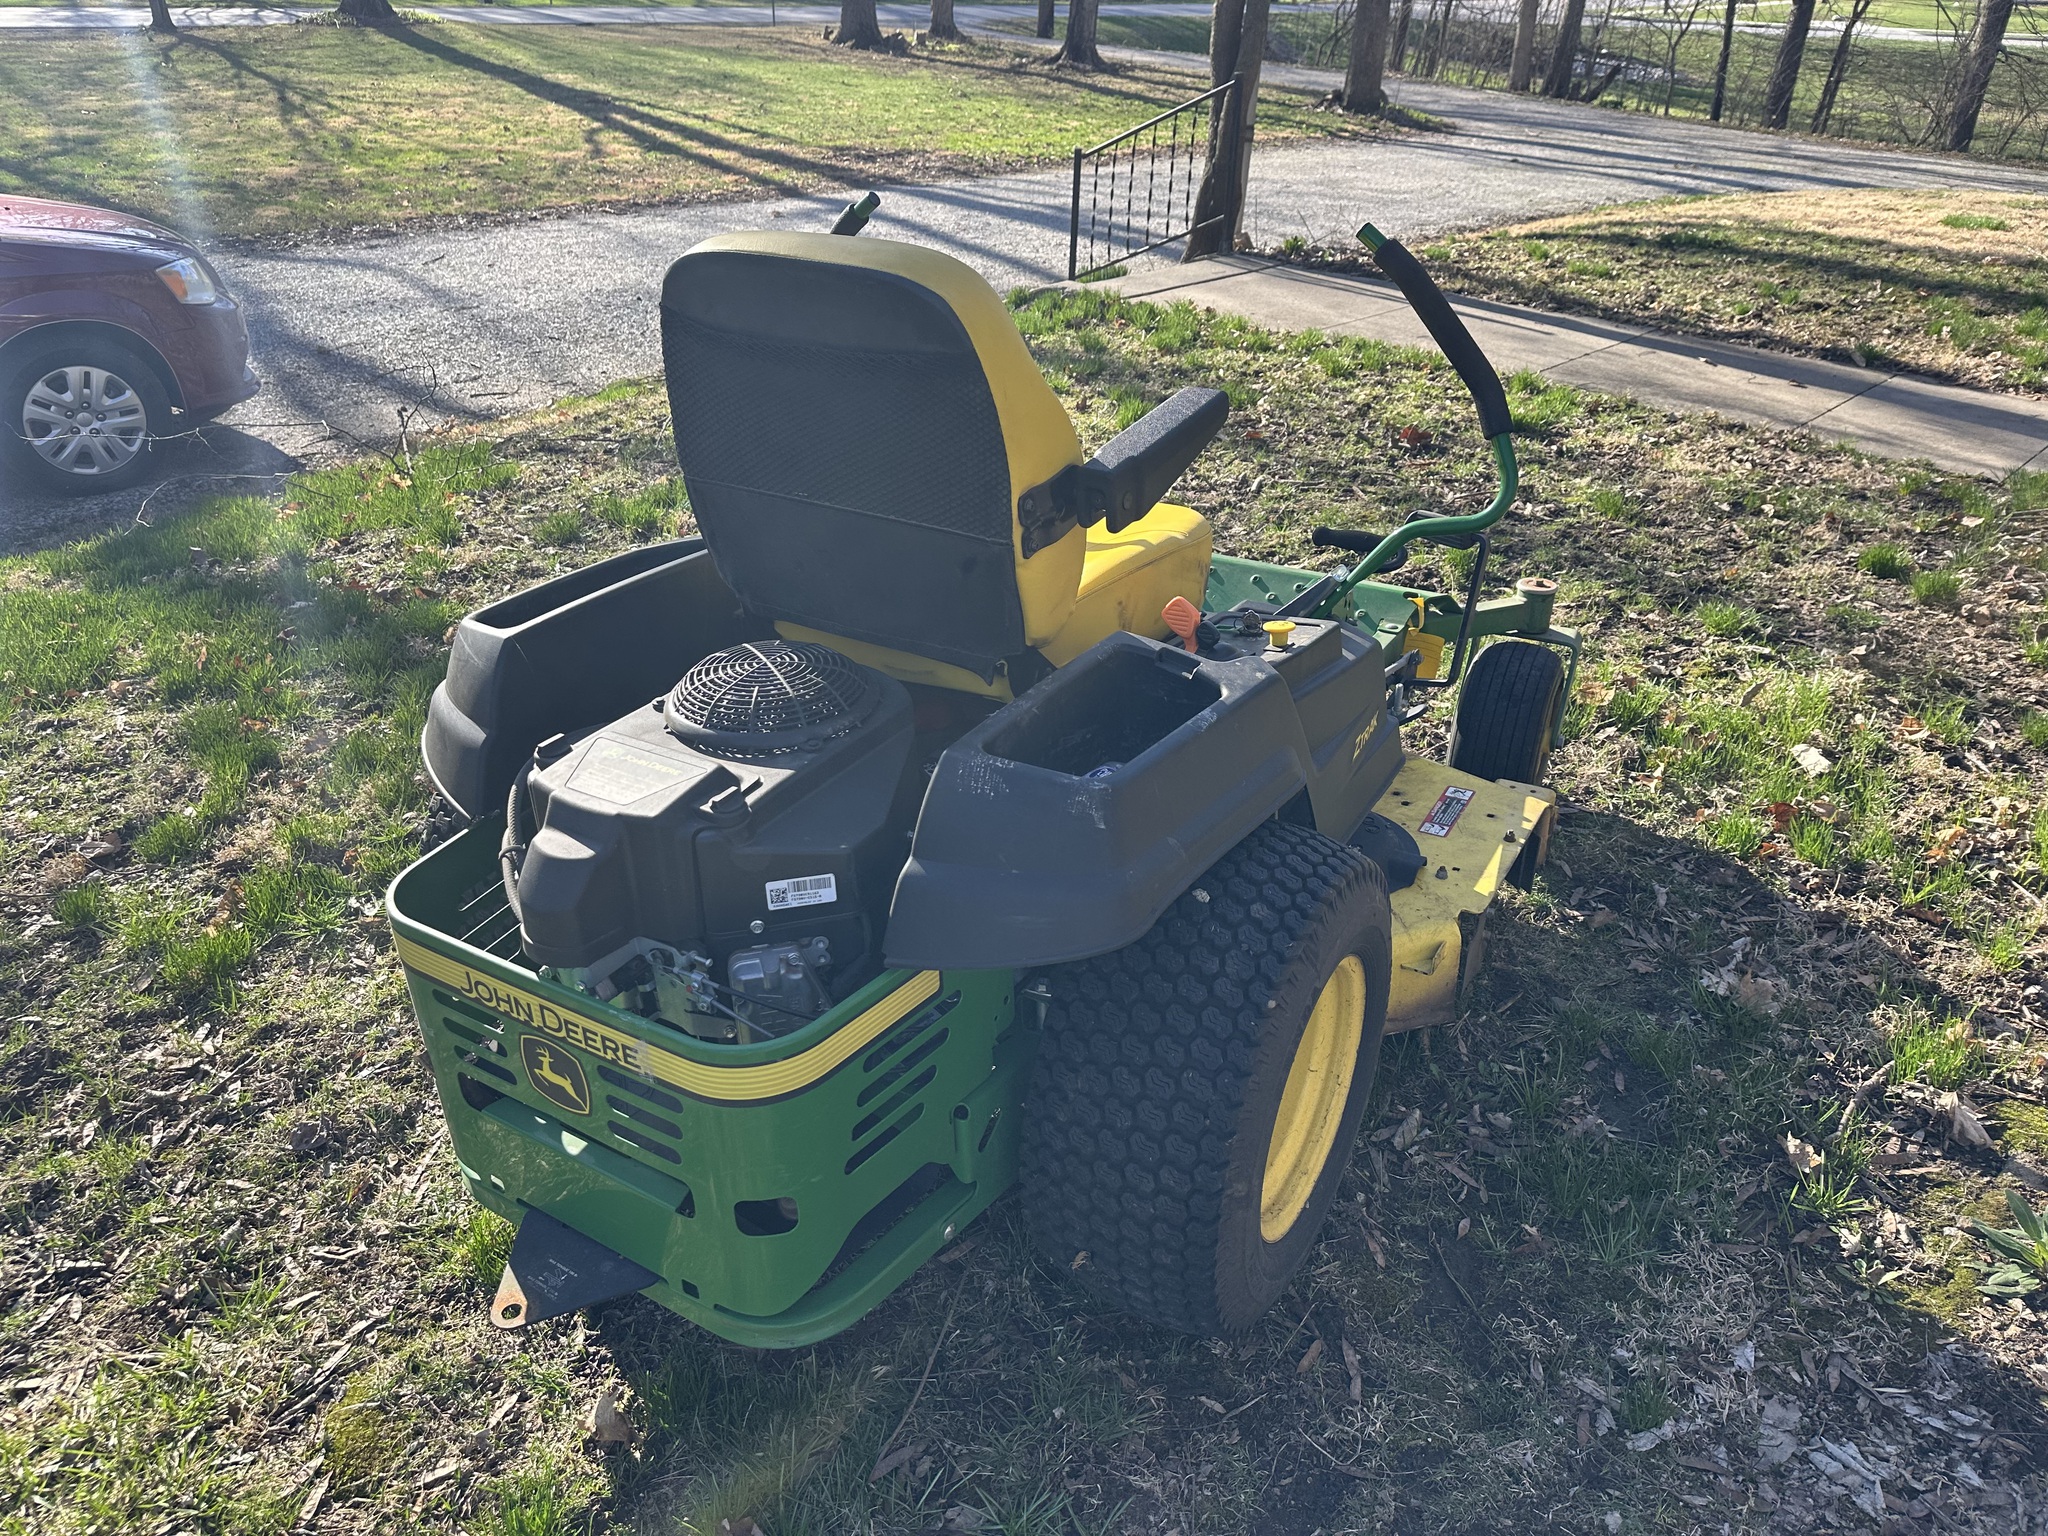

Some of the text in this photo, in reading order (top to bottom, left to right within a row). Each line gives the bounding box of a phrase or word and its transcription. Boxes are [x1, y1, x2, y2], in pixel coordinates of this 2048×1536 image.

[621, 754, 651, 767] JOHN
[460, 971, 643, 1071] JOHN DEERE
